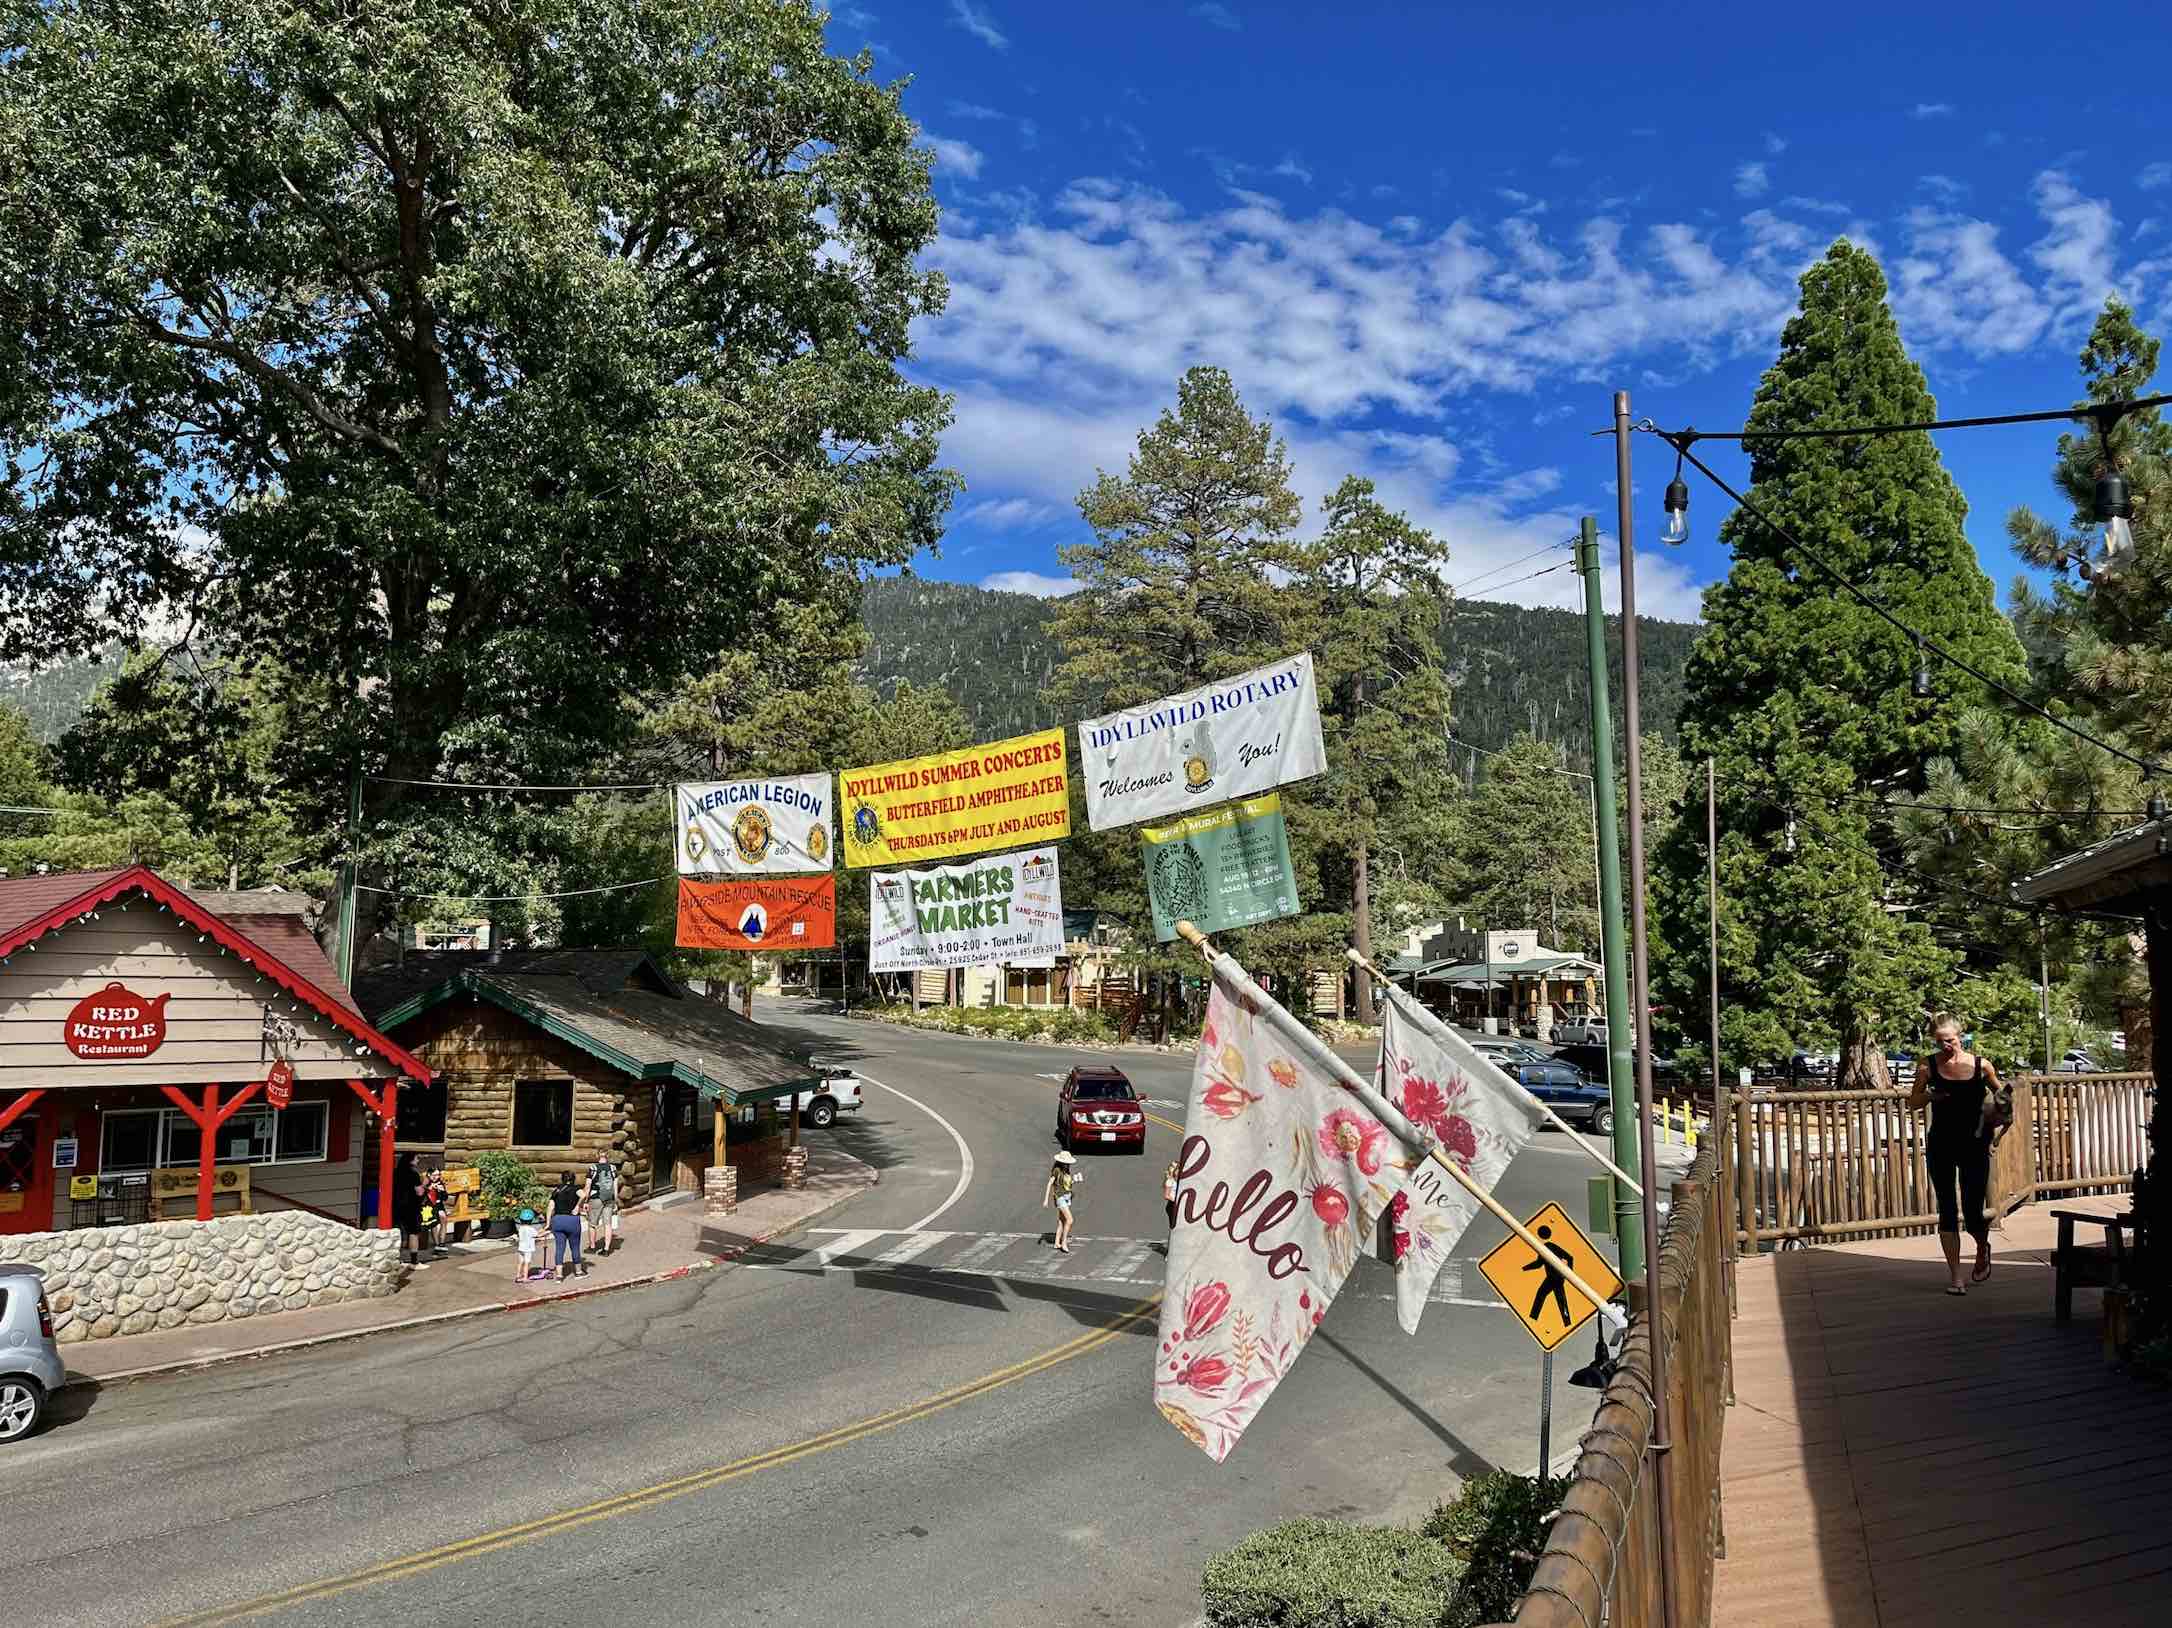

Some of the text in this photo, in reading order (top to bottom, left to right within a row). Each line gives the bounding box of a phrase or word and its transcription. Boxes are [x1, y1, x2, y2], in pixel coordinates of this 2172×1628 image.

[1092, 669, 1300, 748] IDYLLWILD ROTARY
[1238, 733, 1281, 768] You!
[847, 741, 1061, 798] IDYLLWILD SUMMER CONCERTS
[1100, 770, 1174, 798] Welcomes
[688, 783, 823, 821] AMERICAN LEGION
[887, 775, 1064, 821] BUTTERFIELD AMPHITHEATER
[888, 831, 946, 851] THURSDAYS
[969, 823, 997, 840] JULY
[997, 818, 1021, 837] AND
[1022, 809, 1066, 831] AUGUST
[734, 886, 786, 903] MOUNTAIN
[790, 888, 833, 912] RESCUE
[911, 866, 1015, 904] FARMERS
[916, 897, 1012, 935] MARKET
[900, 945, 929, 958] Sunday
[992, 936, 1015, 948] Town
[1016, 932, 1033, 945] Hall
[874, 960, 888, 969] Just
[73, 1023, 157, 1040] KETTLE
[92, 1007, 140, 1021] RED
[78, 1043, 148, 1054] Restaurant
[1171, 1134, 1312, 1280] hello
